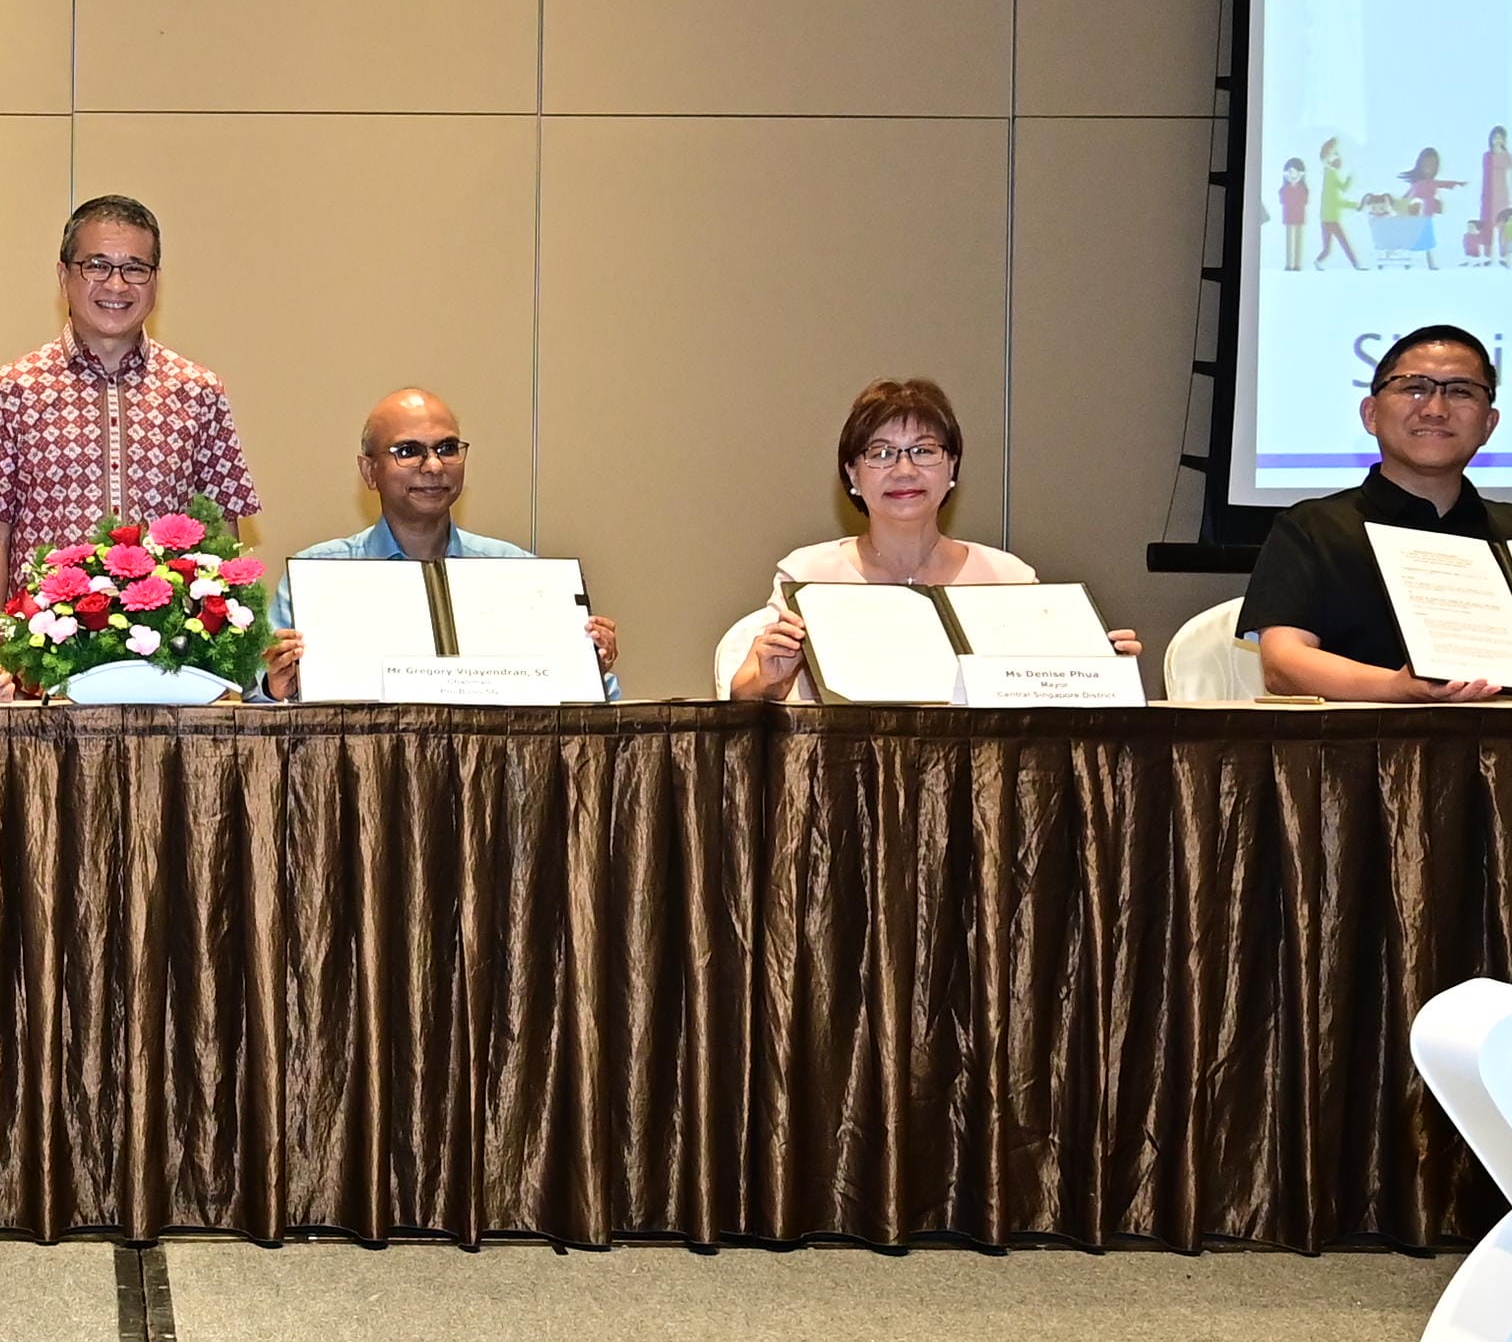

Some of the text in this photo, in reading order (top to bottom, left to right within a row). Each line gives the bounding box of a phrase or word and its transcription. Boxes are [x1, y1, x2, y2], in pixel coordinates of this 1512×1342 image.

[387, 667, 401, 675] Mr
[405, 667, 452, 676] Gregory
[534, 668, 551, 677] SC
[1005, 670, 1100, 679] Ms Denise Phua
